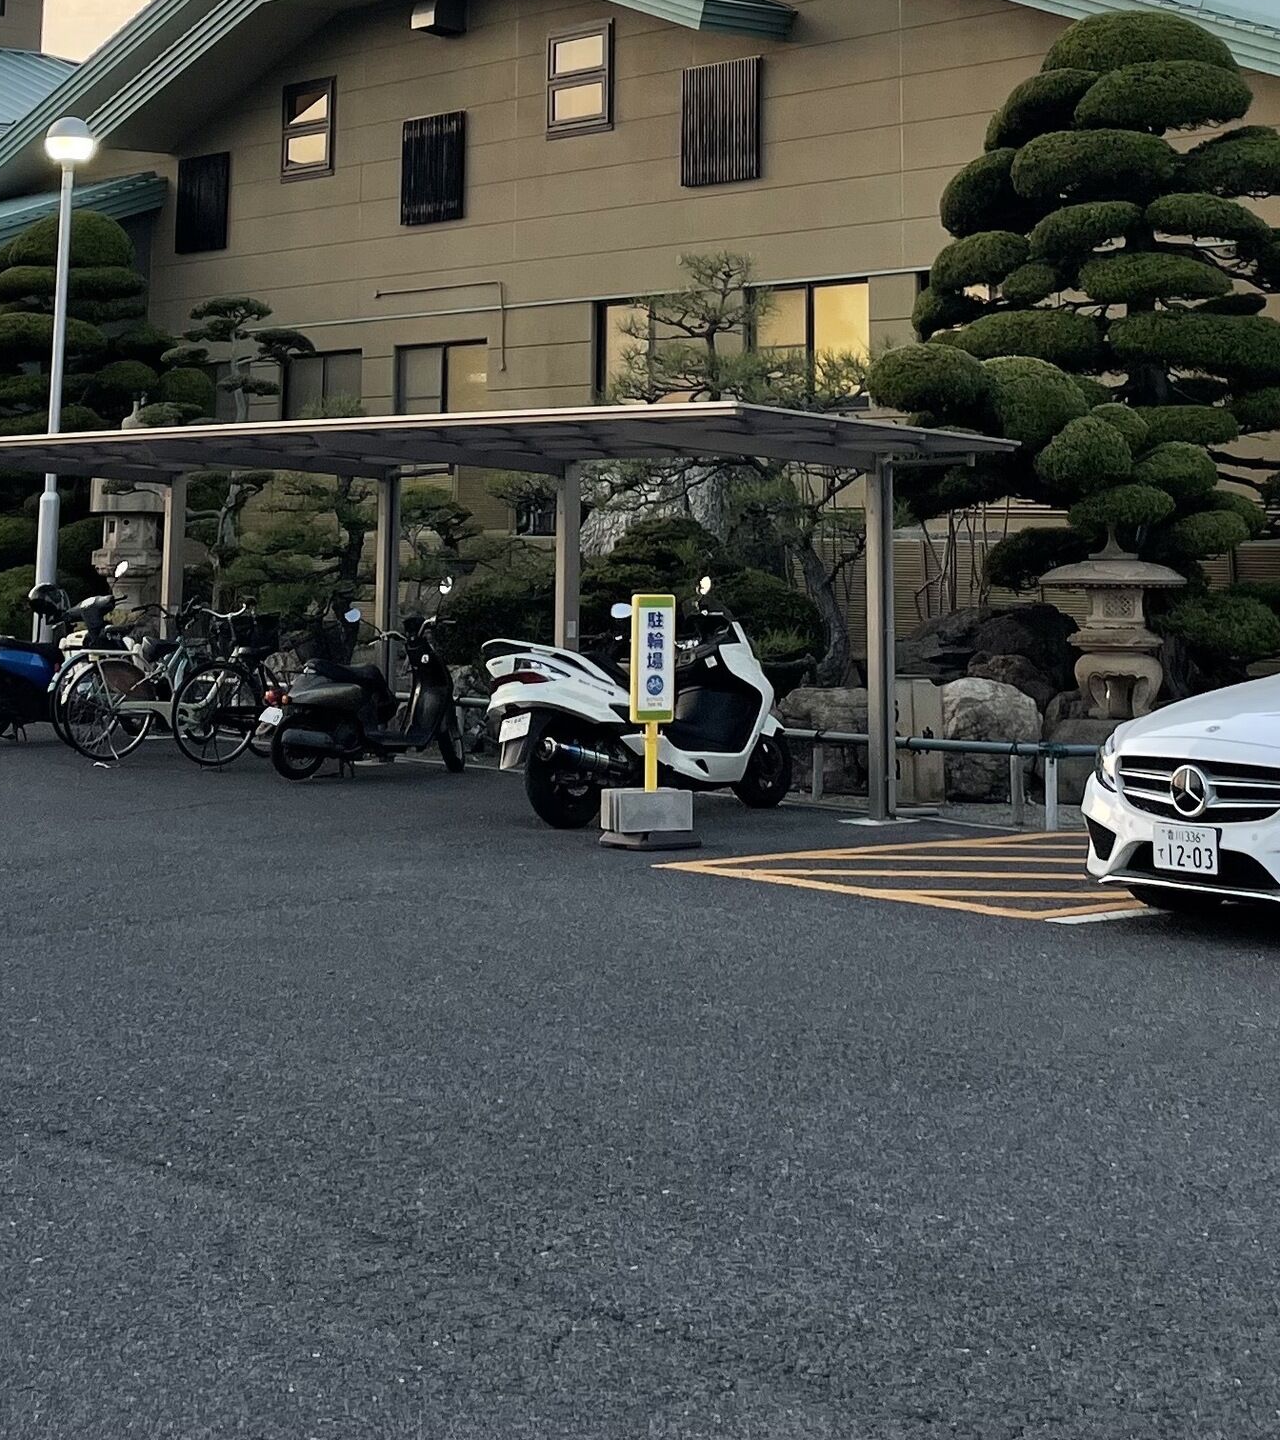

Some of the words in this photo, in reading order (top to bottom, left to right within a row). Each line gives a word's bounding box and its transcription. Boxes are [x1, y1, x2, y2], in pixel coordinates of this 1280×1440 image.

[647, 611, 664, 670] 駐輪場
[1169, 843, 1213, 869] 12-03
